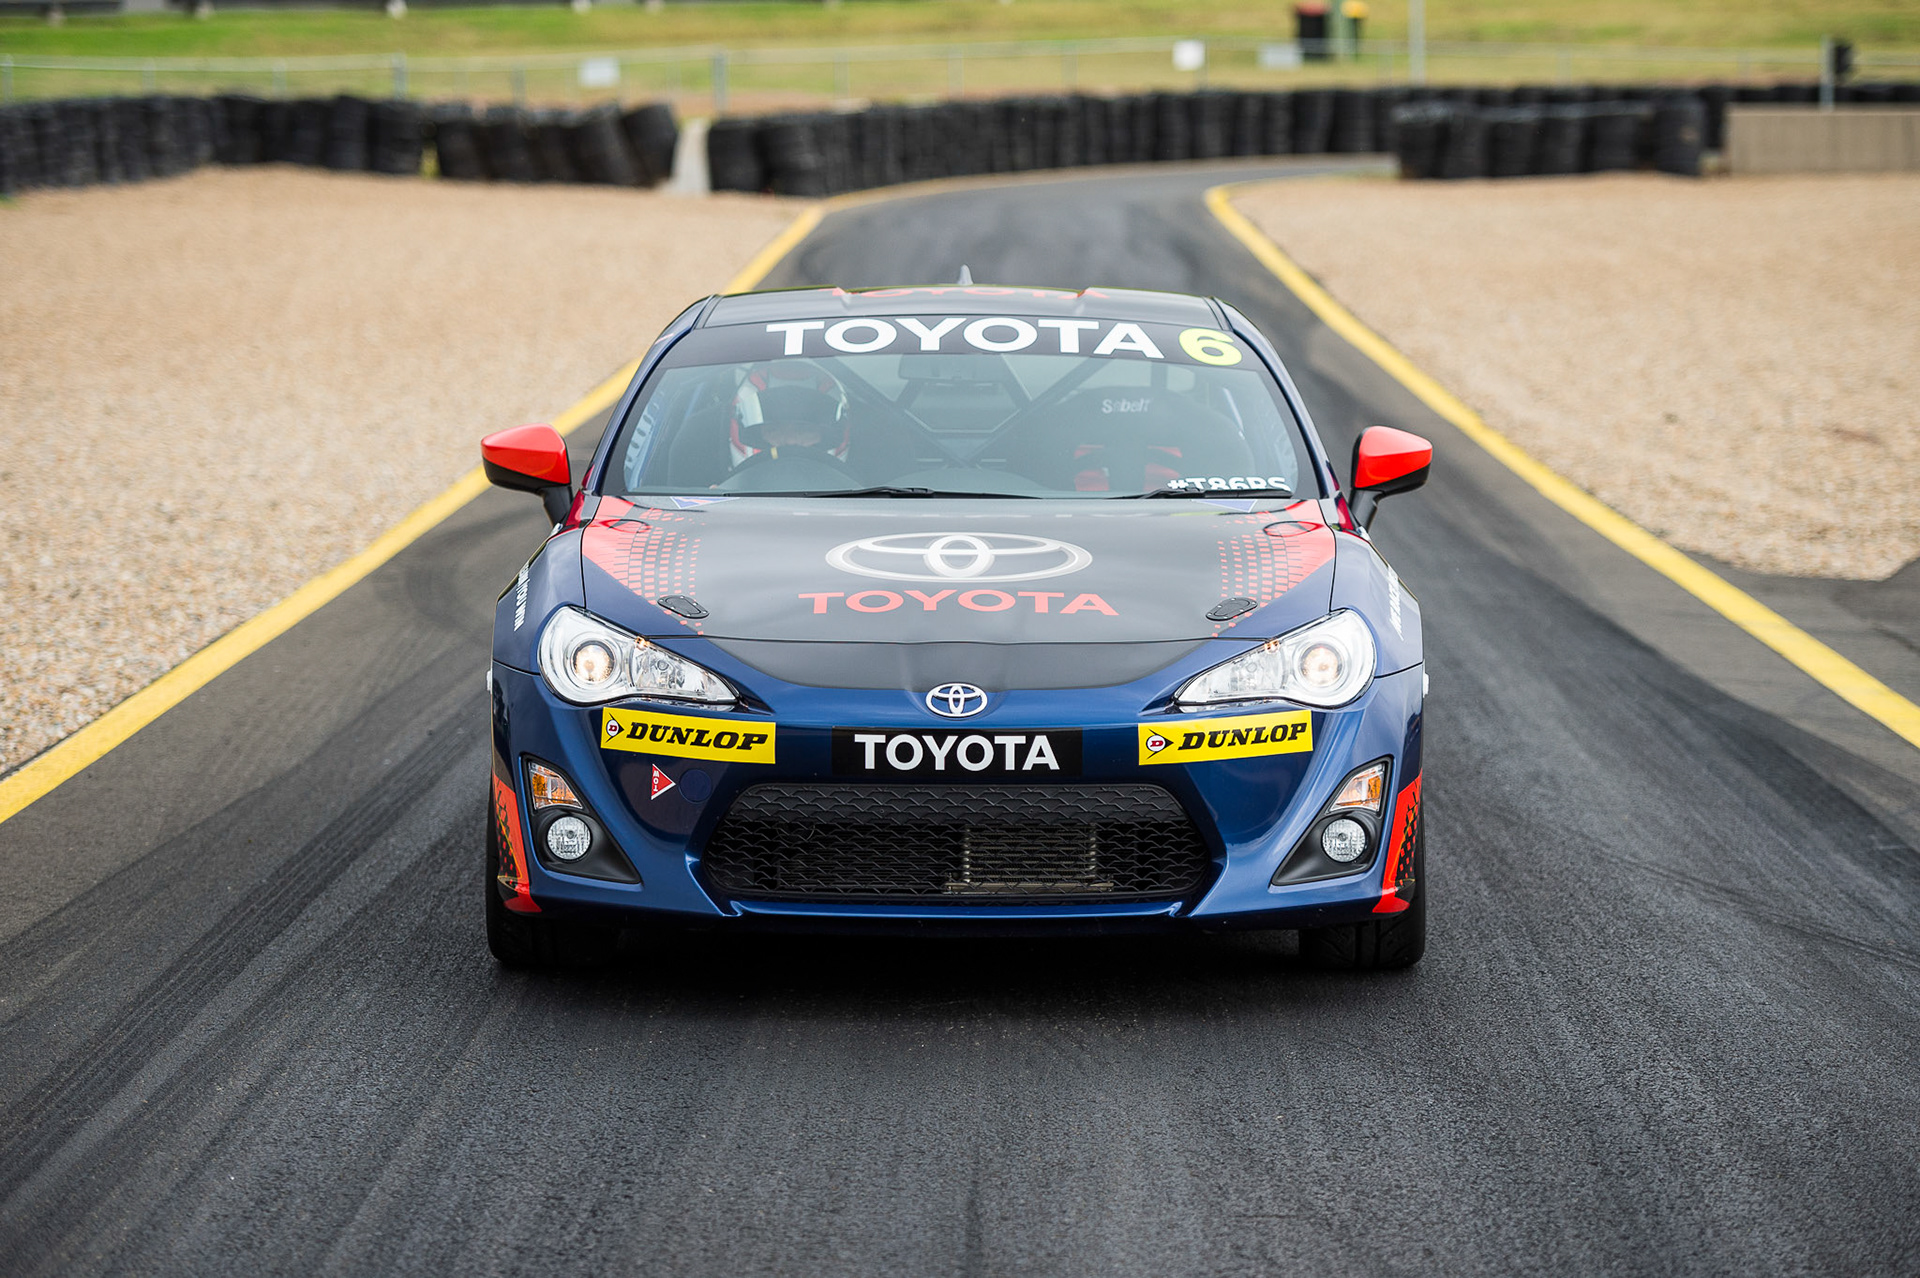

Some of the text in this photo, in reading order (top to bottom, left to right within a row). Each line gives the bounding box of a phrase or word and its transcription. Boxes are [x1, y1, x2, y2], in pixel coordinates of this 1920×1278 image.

[766, 317, 1242, 365] TOYOTA 6
[798, 589, 1119, 616] TOYOTA
[626, 722, 768, 750] DUNLOP
[1178, 722, 1307, 751] DUNLOP
[854, 734, 1060, 771] TOYOTA
